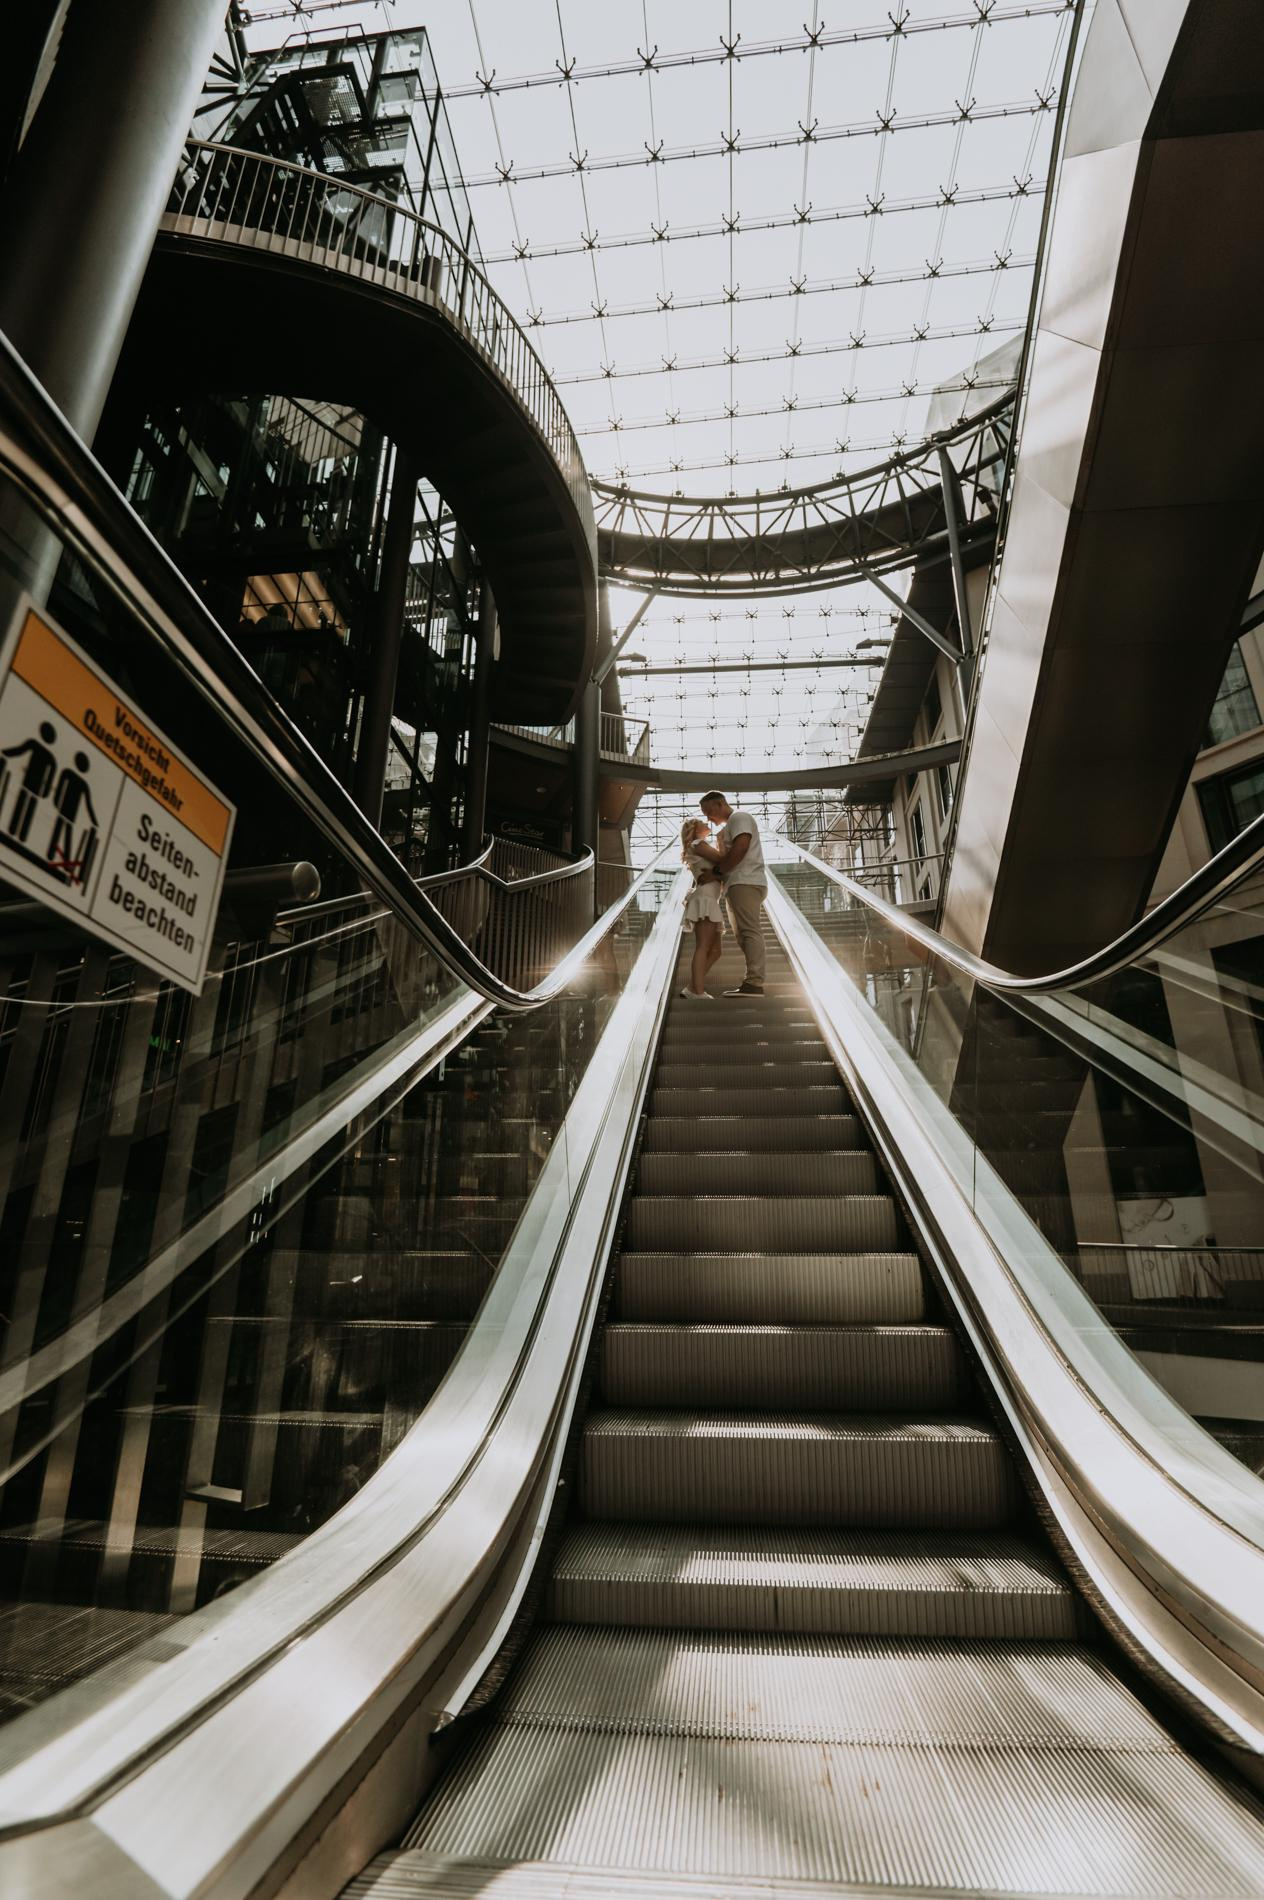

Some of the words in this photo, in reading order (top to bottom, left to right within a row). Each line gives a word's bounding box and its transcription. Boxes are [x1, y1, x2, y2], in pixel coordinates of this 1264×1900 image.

[83, 708, 184, 812] Quetschgefahr
[115, 706, 170, 774] Vorsicht
[137, 814, 200, 879] Seiten-
[109, 874, 195, 954] beachten
[125, 851, 197, 917] abstand
